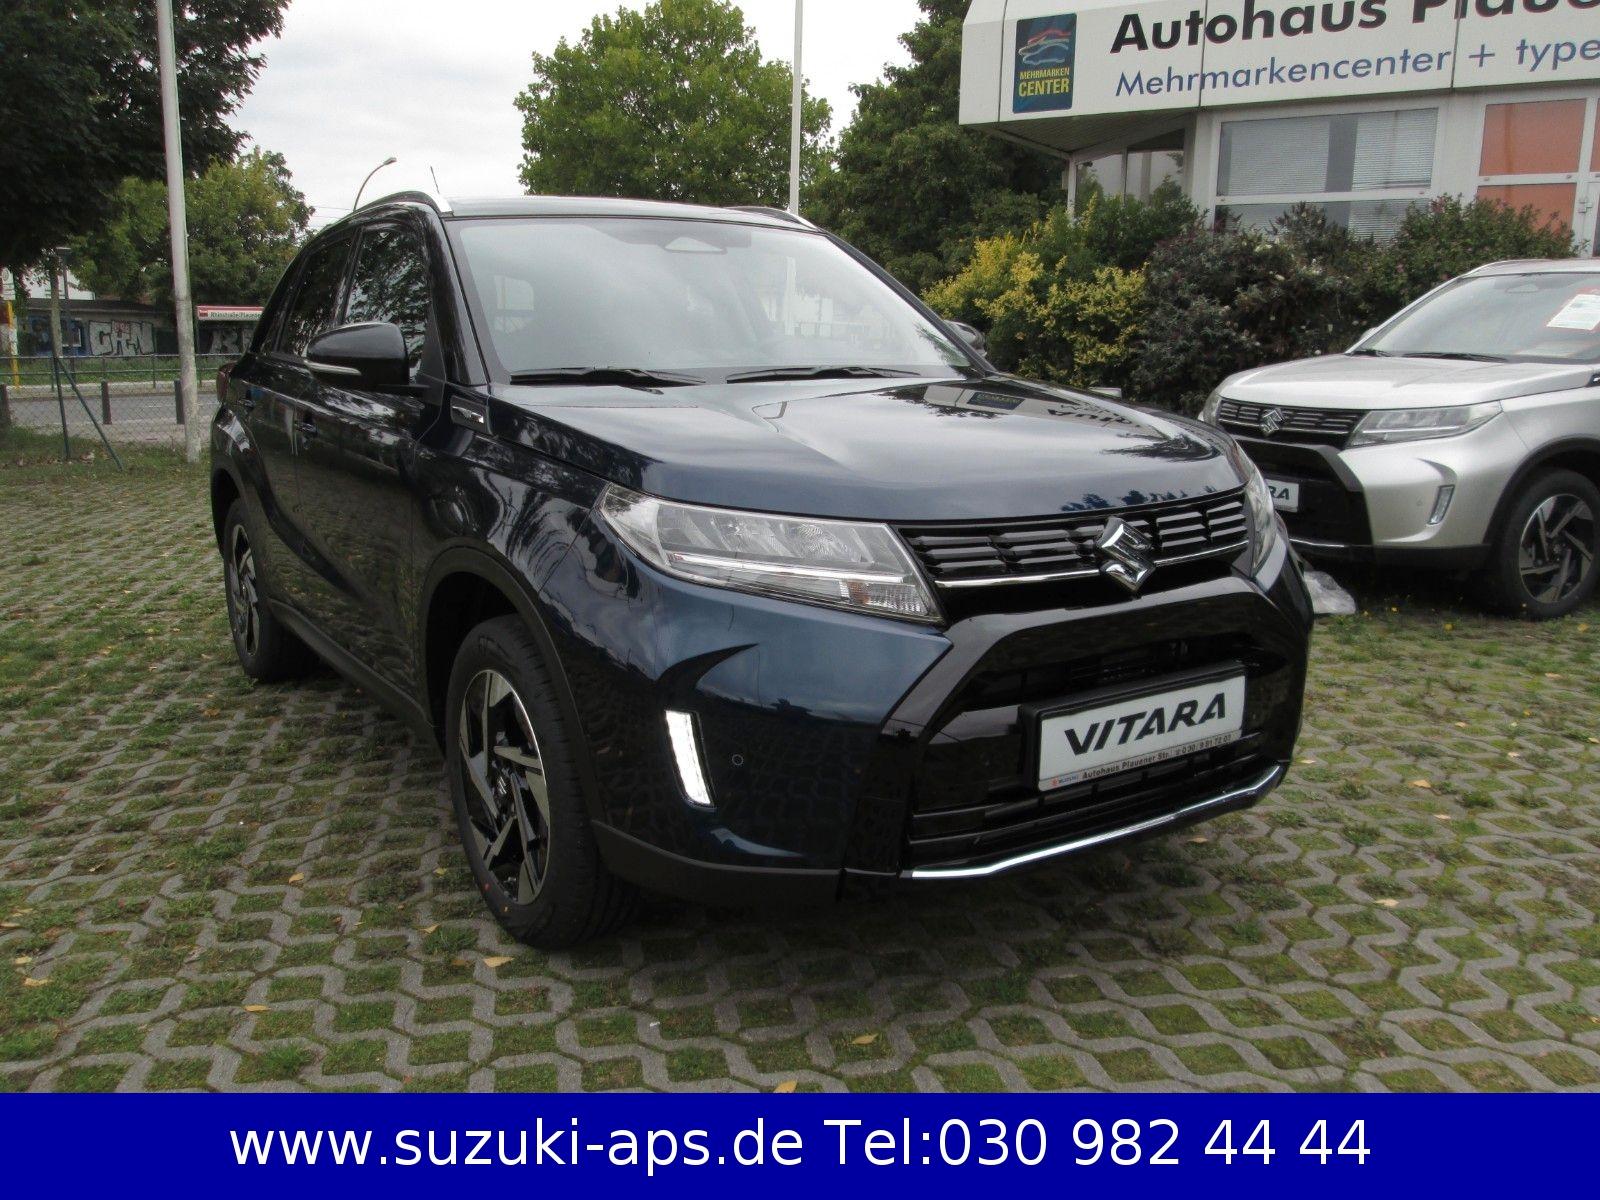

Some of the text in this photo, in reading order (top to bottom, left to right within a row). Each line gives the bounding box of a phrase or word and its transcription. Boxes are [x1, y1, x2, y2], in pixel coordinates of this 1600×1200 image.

[1110, 0, 1387, 54] Autohaus
[1019, 67, 1070, 80] MEHRMARKEN
[1115, 38, 1600, 97] Mehrmarkencenter + type
[1018, 78, 1070, 97] CENTER
[1064, 692, 1226, 756] VITARA
[1082, 765, 1120, 779] Autohaus
[1121, 756, 1156, 769] Plauener
